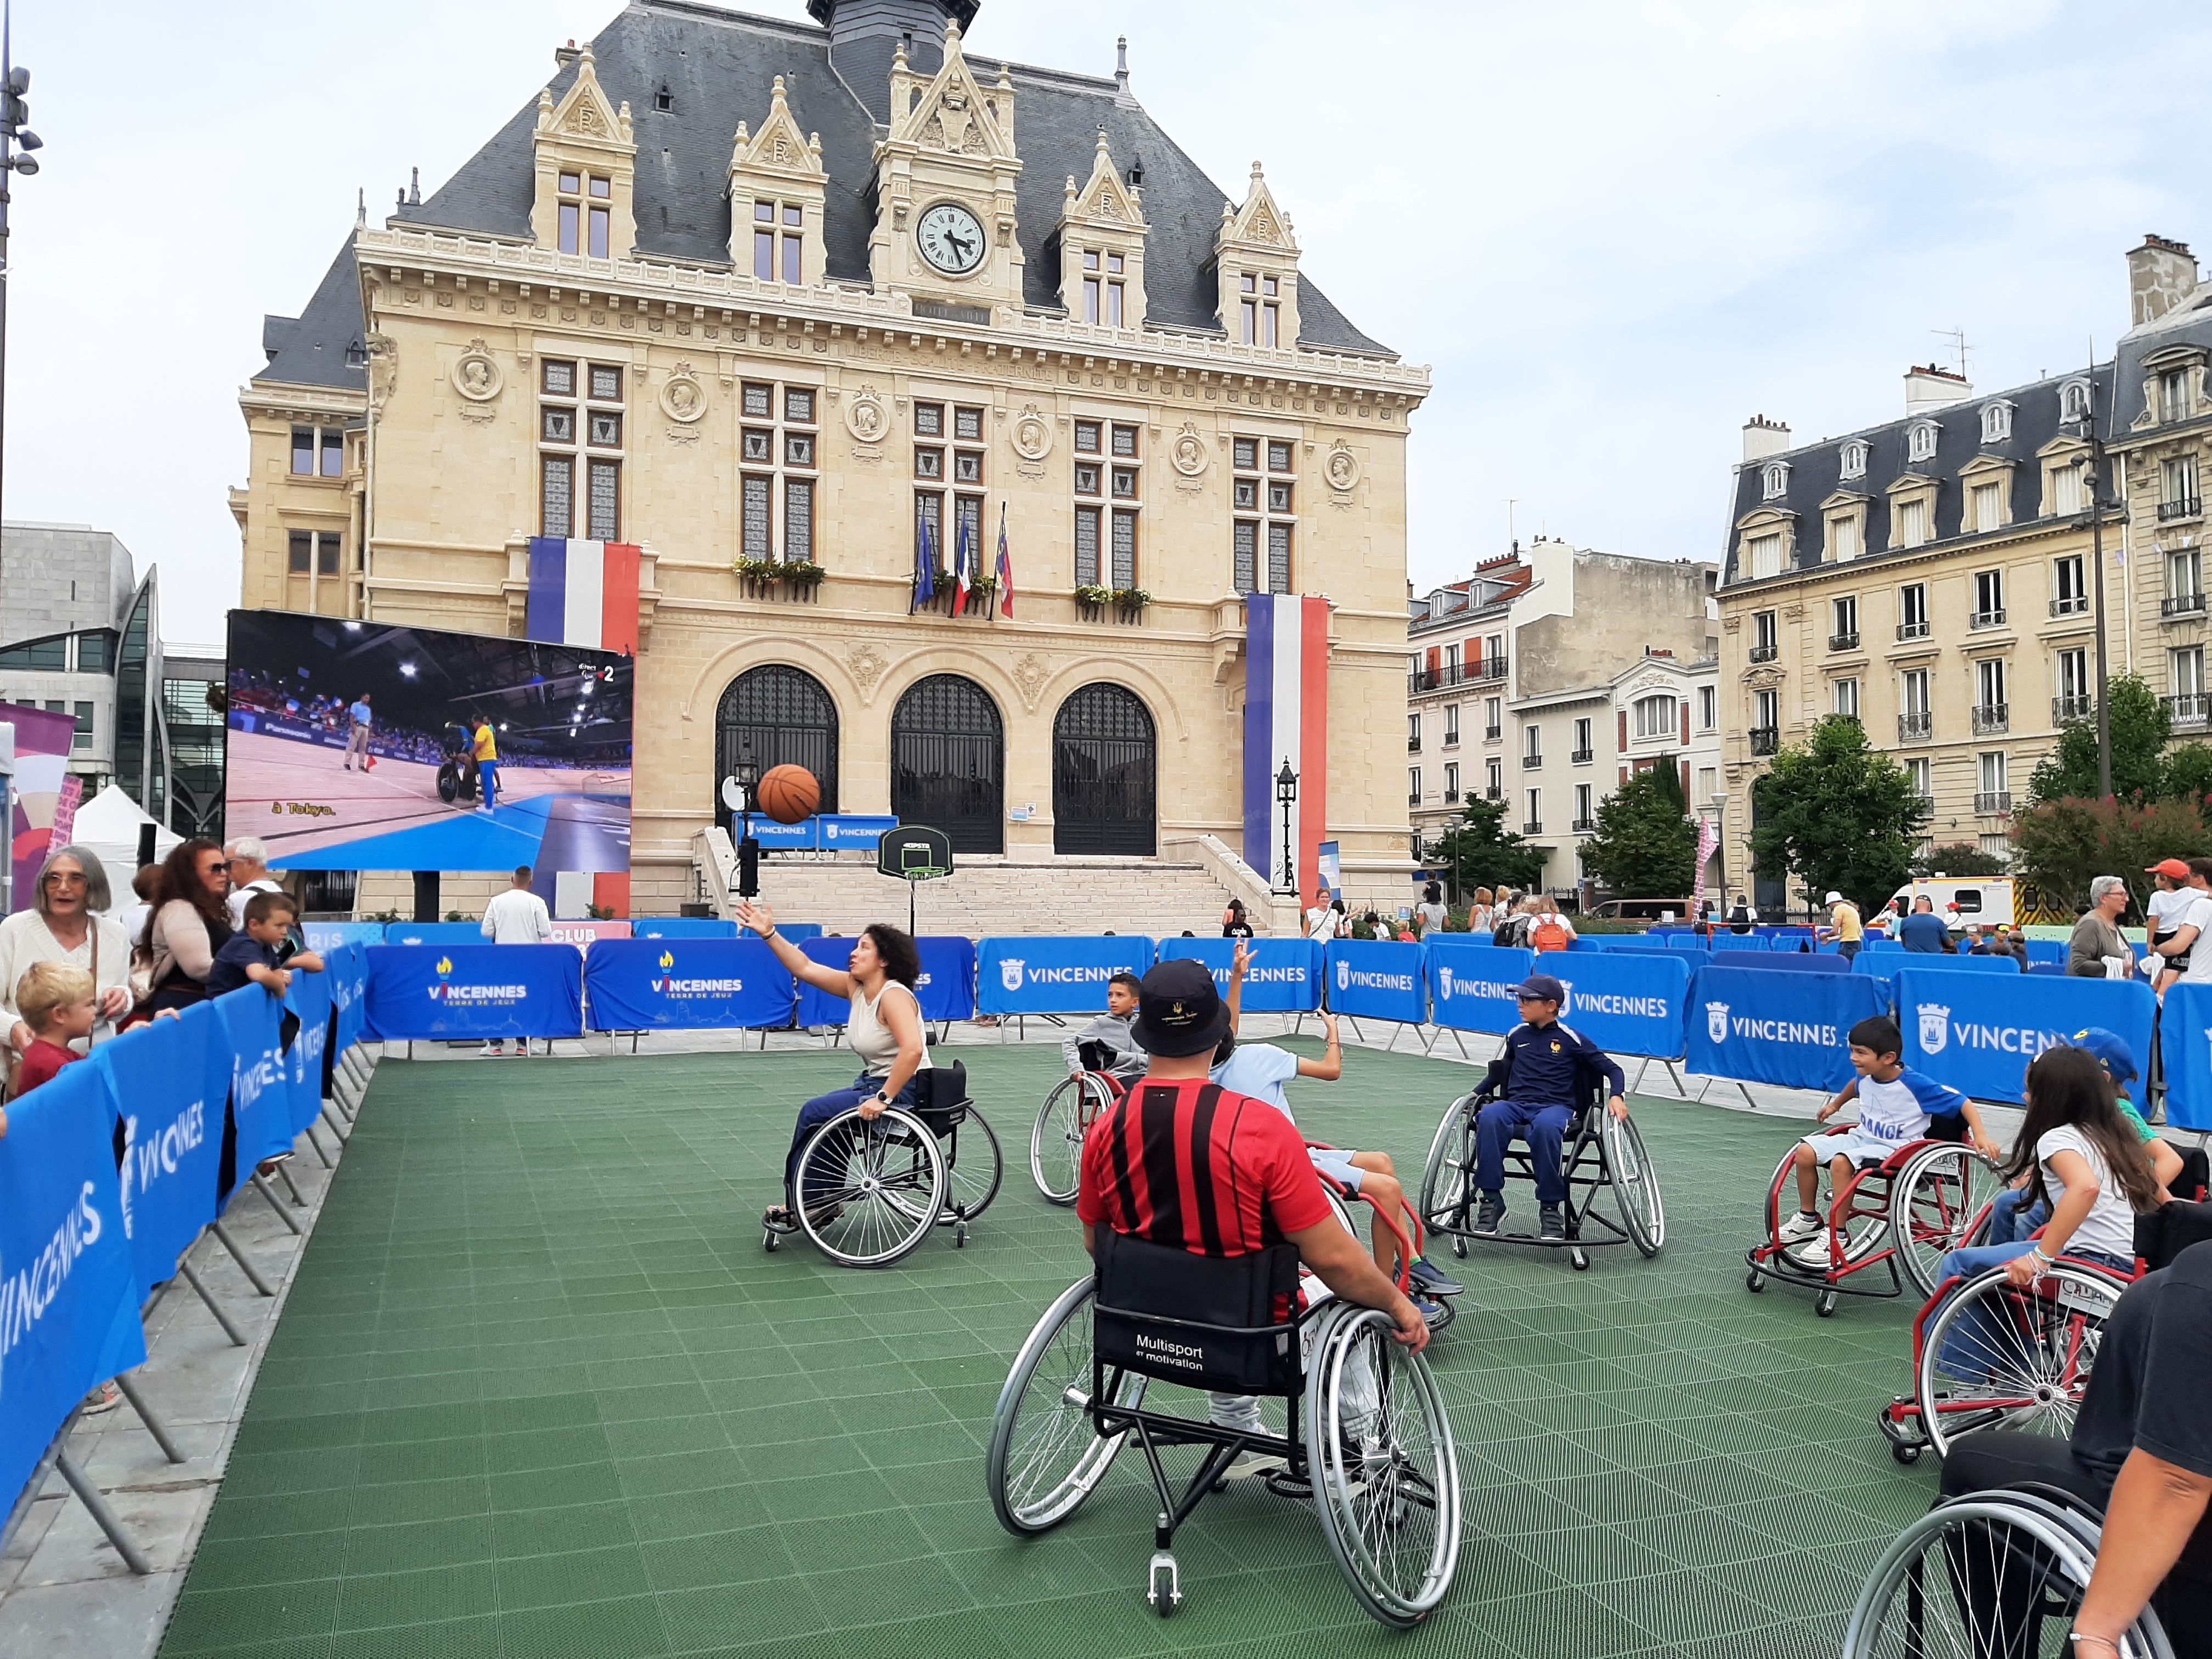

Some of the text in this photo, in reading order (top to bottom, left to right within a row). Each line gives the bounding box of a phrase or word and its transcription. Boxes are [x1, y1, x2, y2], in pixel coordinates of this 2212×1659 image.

[604, 665, 613, 682] 2
[272, 802, 336, 817] à Tokyo.
[755, 826, 806, 834] VINCENNES
[309, 933, 343, 948] RIS
[550, 929, 596, 942] CLUB
[651, 979, 742, 992] VINCENNES
[1350, 971, 1413, 991] VINCENNES
[1453, 979, 1519, 1001] VINCENNE
[428, 985, 527, 1000] VINCENNES
[1574, 993, 1667, 1017] VINCENNES
[1954, 1023, 2067, 1054] VINCEN
[1860, 1112, 1905, 1139] RANCE
[1137, 1334, 1203, 1359] Multisport
[1146, 1352, 1203, 1371] motivation
